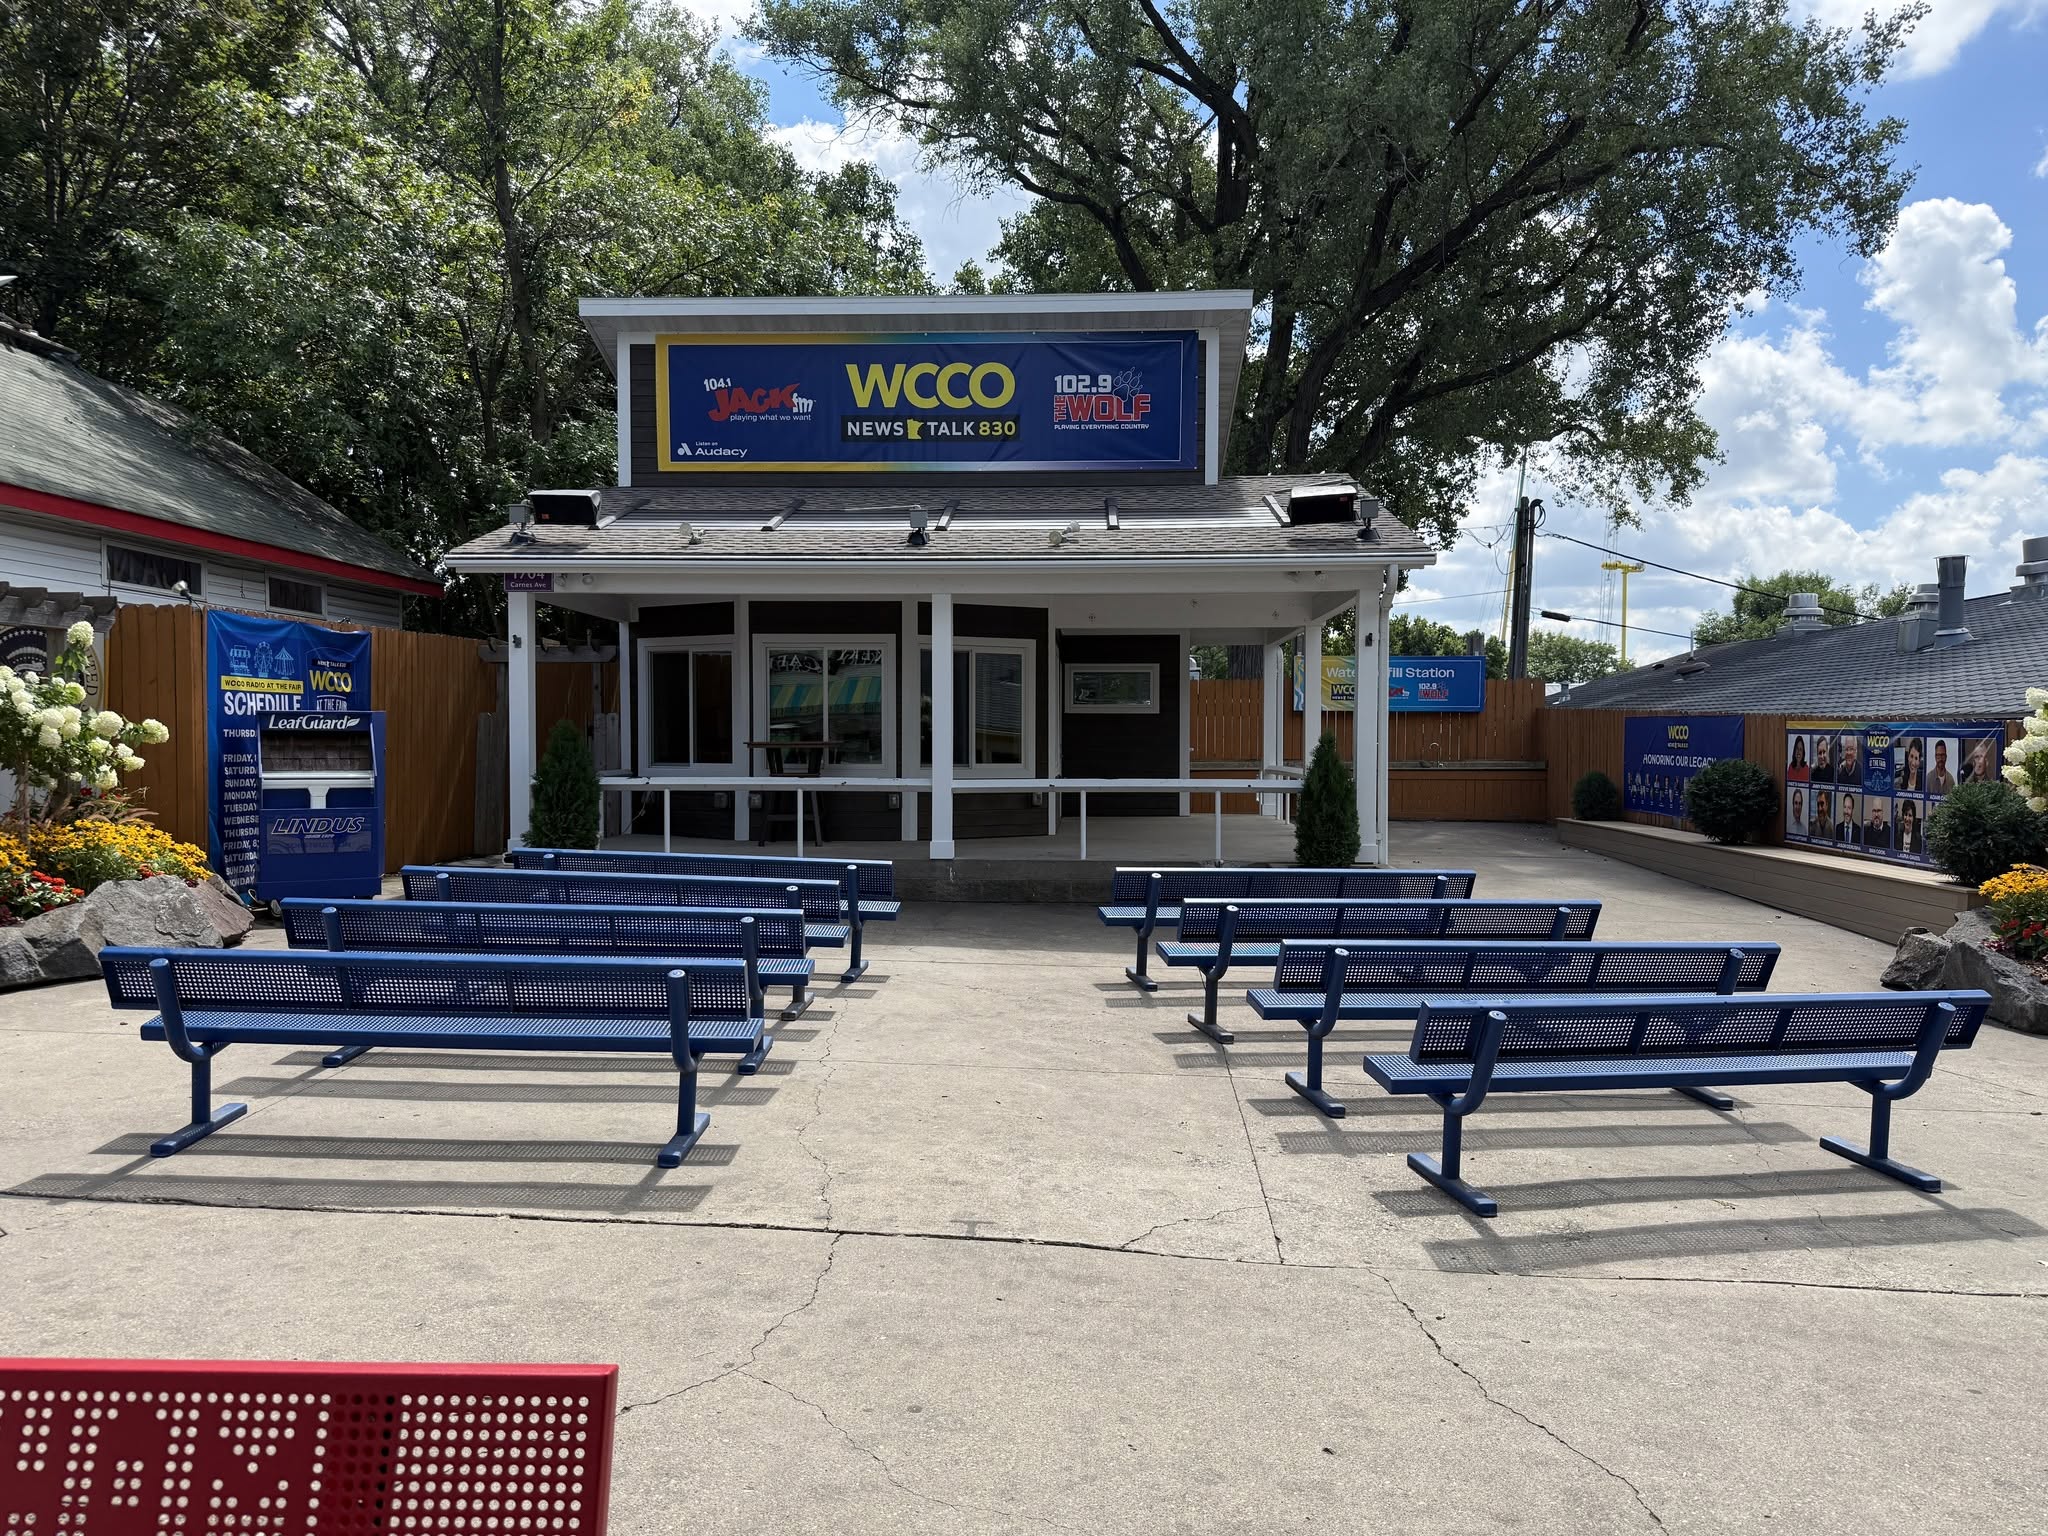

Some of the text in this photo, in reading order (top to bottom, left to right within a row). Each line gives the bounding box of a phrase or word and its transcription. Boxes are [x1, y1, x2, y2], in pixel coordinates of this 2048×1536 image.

[704, 377, 731, 392] 104.1
[846, 362, 1016, 409] WCCO
[1054, 374, 1112, 393] 102.9
[708, 383, 814, 422] JACK fm
[1053, 394, 1067, 422] THE
[1066, 394, 1151, 422] WOLF
[730, 414, 757, 422] playing
[759, 413, 778, 421] what
[793, 413, 811, 421] want
[847, 421, 1016, 436] NEWS TALK 830
[695, 447, 748, 458] Audacy
[1405, 667, 1455, 678] Station
[224, 679, 245, 688] WCCO
[246, 680, 265, 689] RADIO
[288, 683, 301, 691] FAIR
[309, 669, 352, 693] WCCO
[224, 691, 302, 715] SCHEDULE
[324, 698, 335, 711] THE
[268, 714, 348, 730] LeafGuard
[223, 729, 257, 738] THURSD
[1667, 725, 1689, 740] WCCO
[1867, 735, 1890, 747] WCCO
[1642, 754, 1674, 766] HONORING
[1675, 755, 1689, 767] OUR
[224, 766, 257, 775] SATURD
[271, 817, 365, 835] LINDUS
